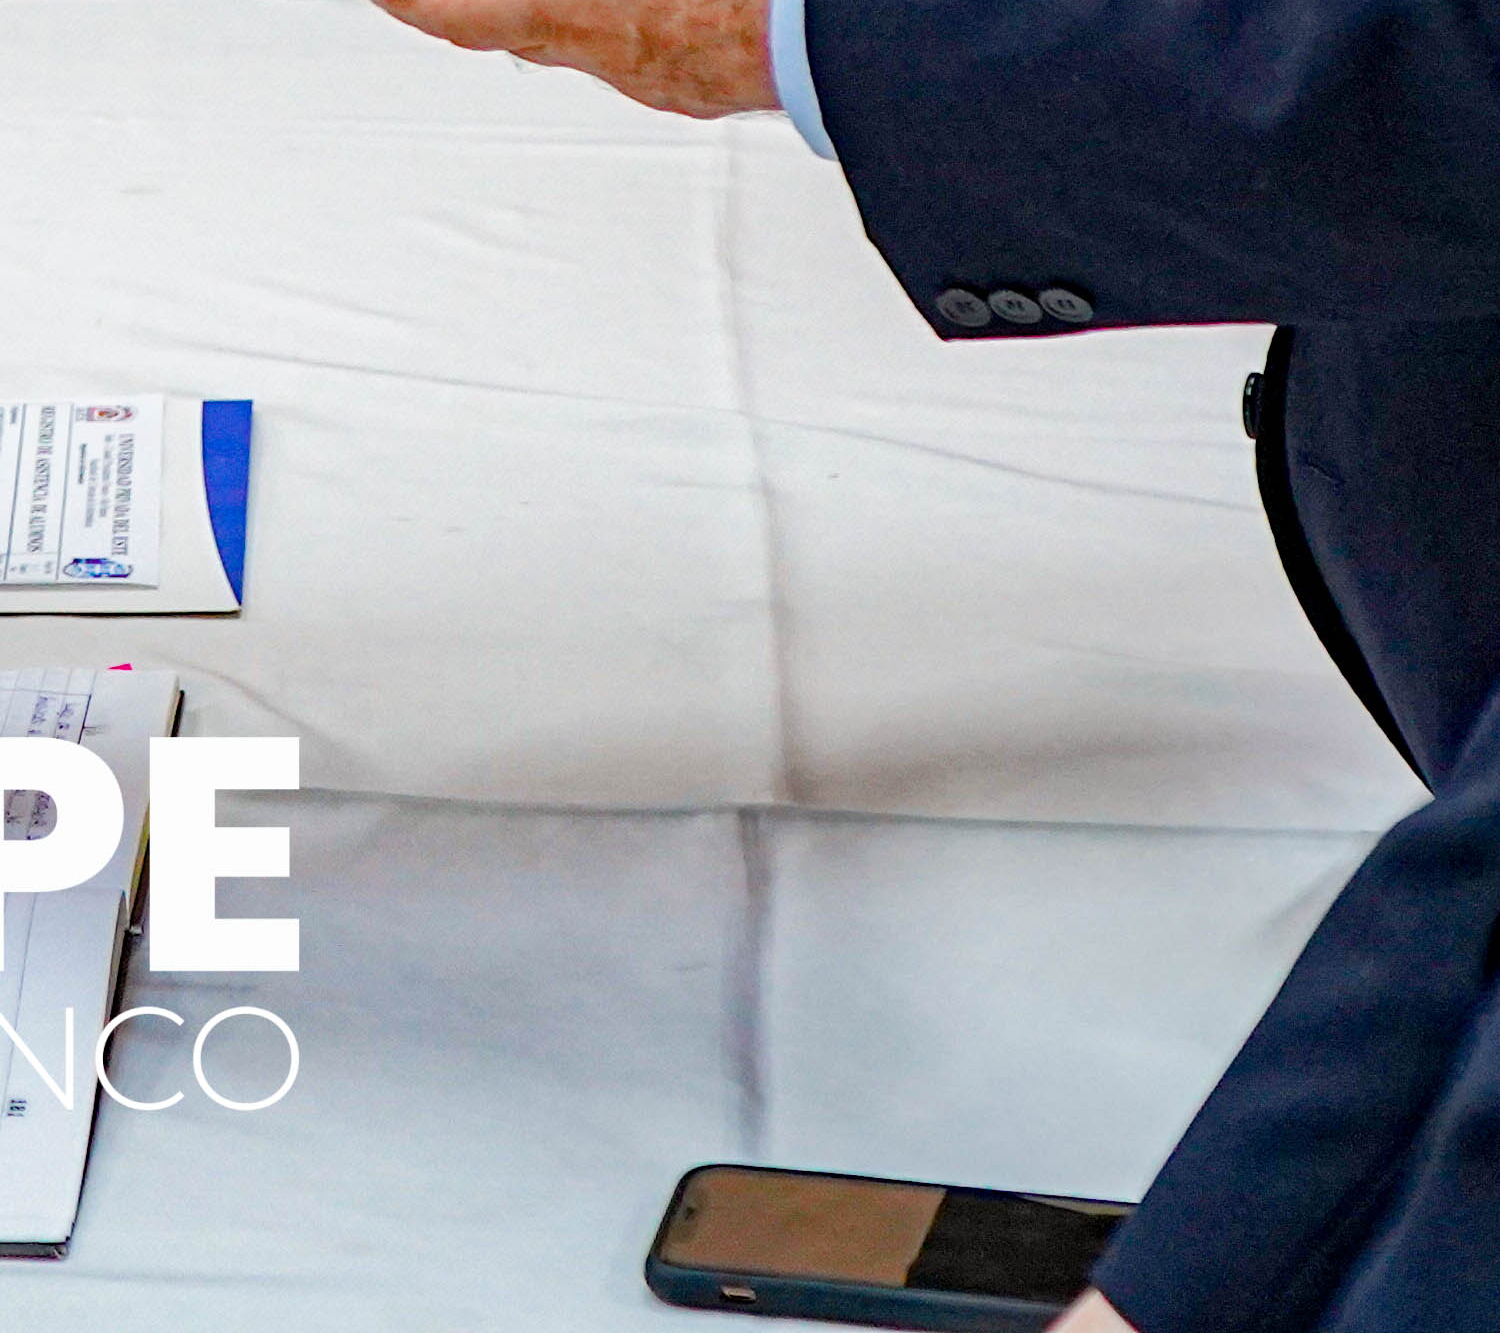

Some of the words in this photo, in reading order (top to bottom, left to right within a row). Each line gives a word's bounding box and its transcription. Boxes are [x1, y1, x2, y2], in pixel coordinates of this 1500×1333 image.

[38, 405, 56, 443] REGISTRO
[37, 446, 54, 455] DE
[117, 433, 135, 487] UNIVERSIDAD
[32, 457, 52, 502] ASISTENCIA
[31, 504, 48, 514] DE
[114, 488, 132, 519] PRIVADA
[27, 516, 46, 553] ALUMNOS
[112, 519, 128, 535] DEL
[111, 536, 128, 556] ESTE
